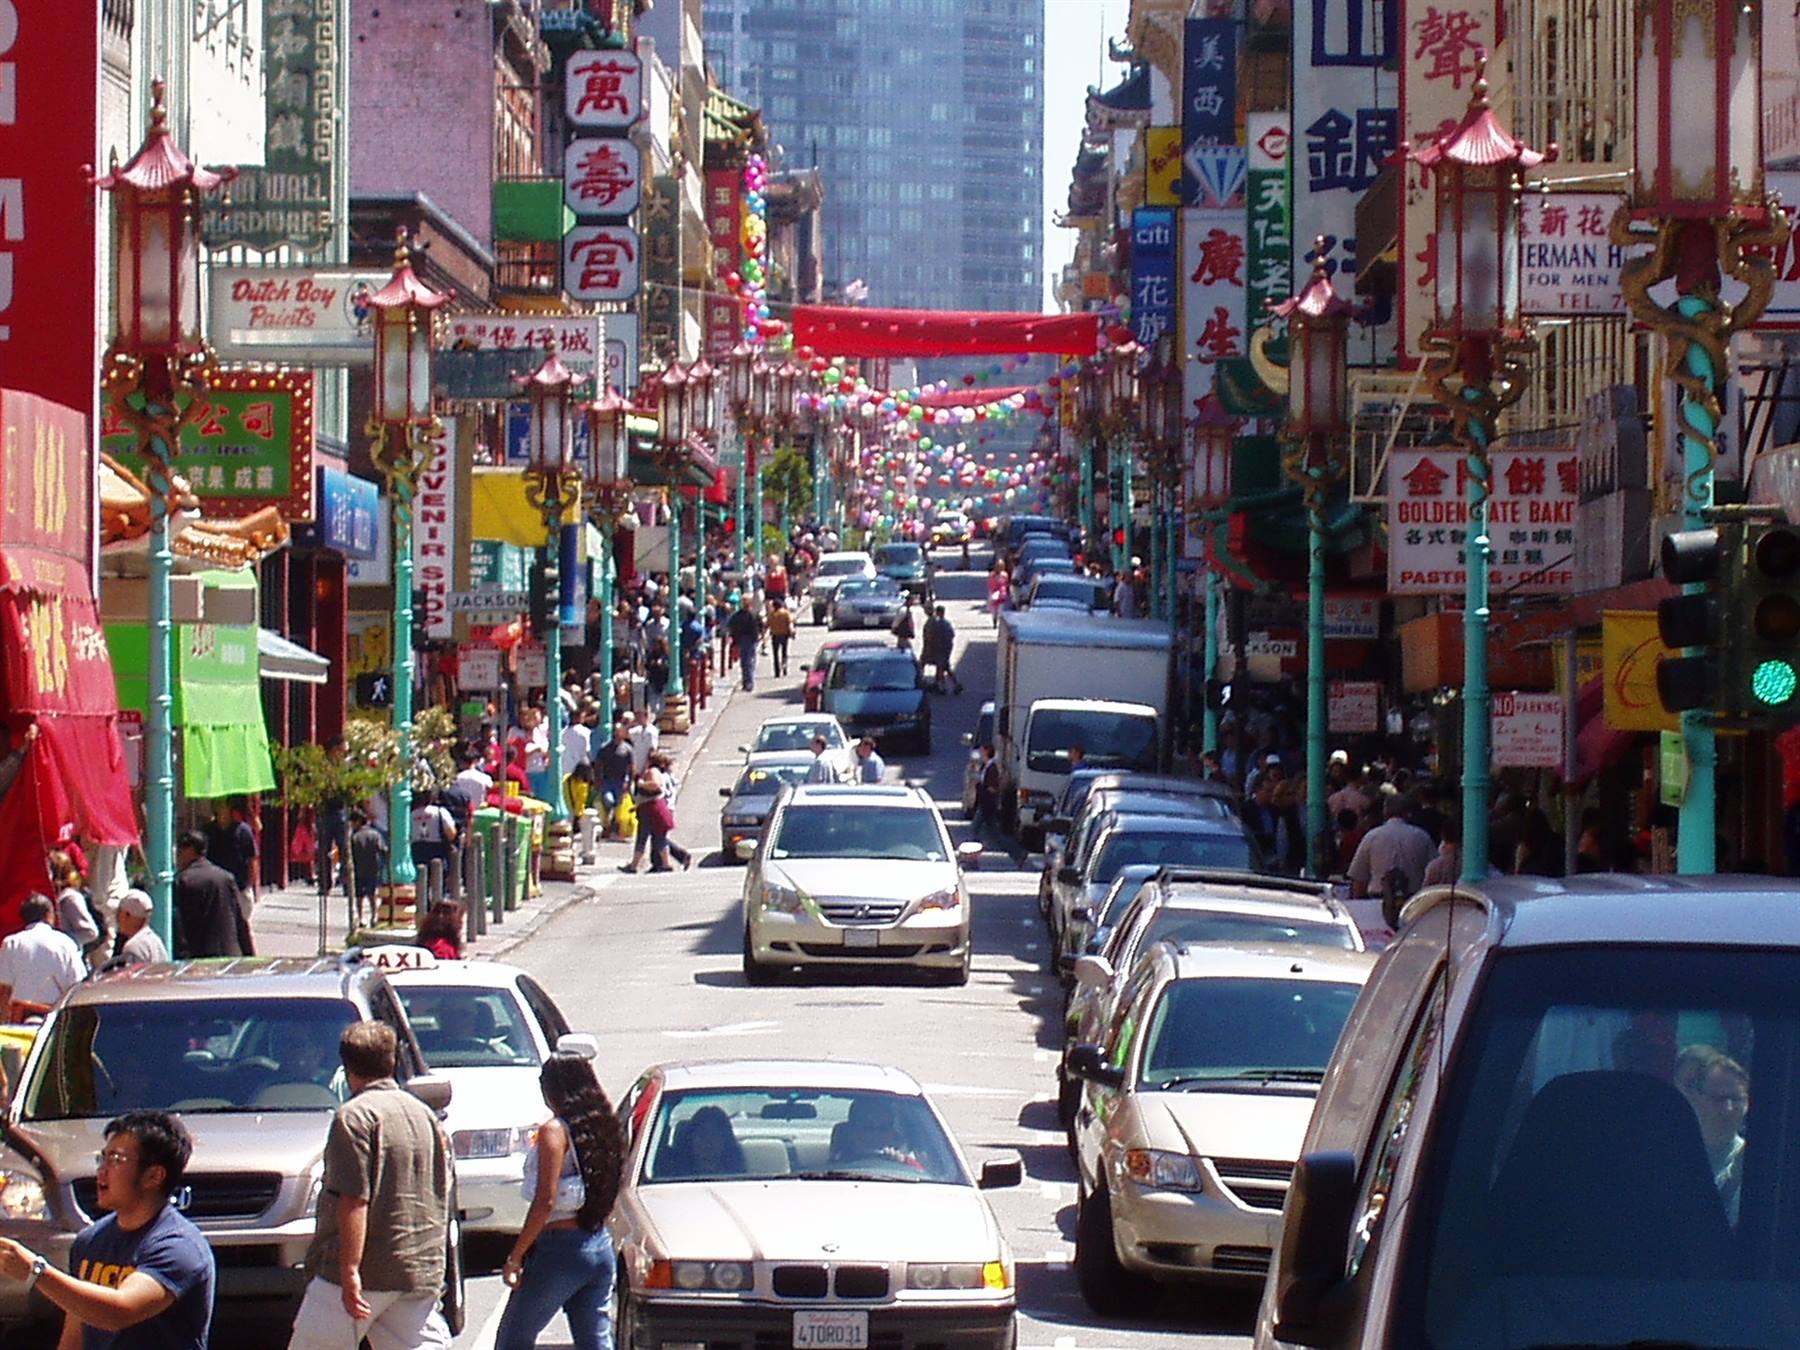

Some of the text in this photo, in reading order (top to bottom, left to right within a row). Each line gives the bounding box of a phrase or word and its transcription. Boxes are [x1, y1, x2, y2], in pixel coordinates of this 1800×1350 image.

[570, 58, 636, 291] 萬壽宮
[1136, 227, 1169, 245] citi
[1251, 178, 1291, 340] 天仁茗
[1520, 243, 1597, 268] ERMAN
[1528, 273, 1608, 286] FOR MEN
[232, 277, 336, 309] Dutch Boy
[1558, 293, 1600, 309] TEL.
[250, 305, 317, 328] Paints
[1137, 275, 1169, 368] 花旗
[1399, 501, 1466, 524] GOLDEN
[1401, 571, 1503, 584] PASTRS
[453, 594, 529, 607] JACKSON
